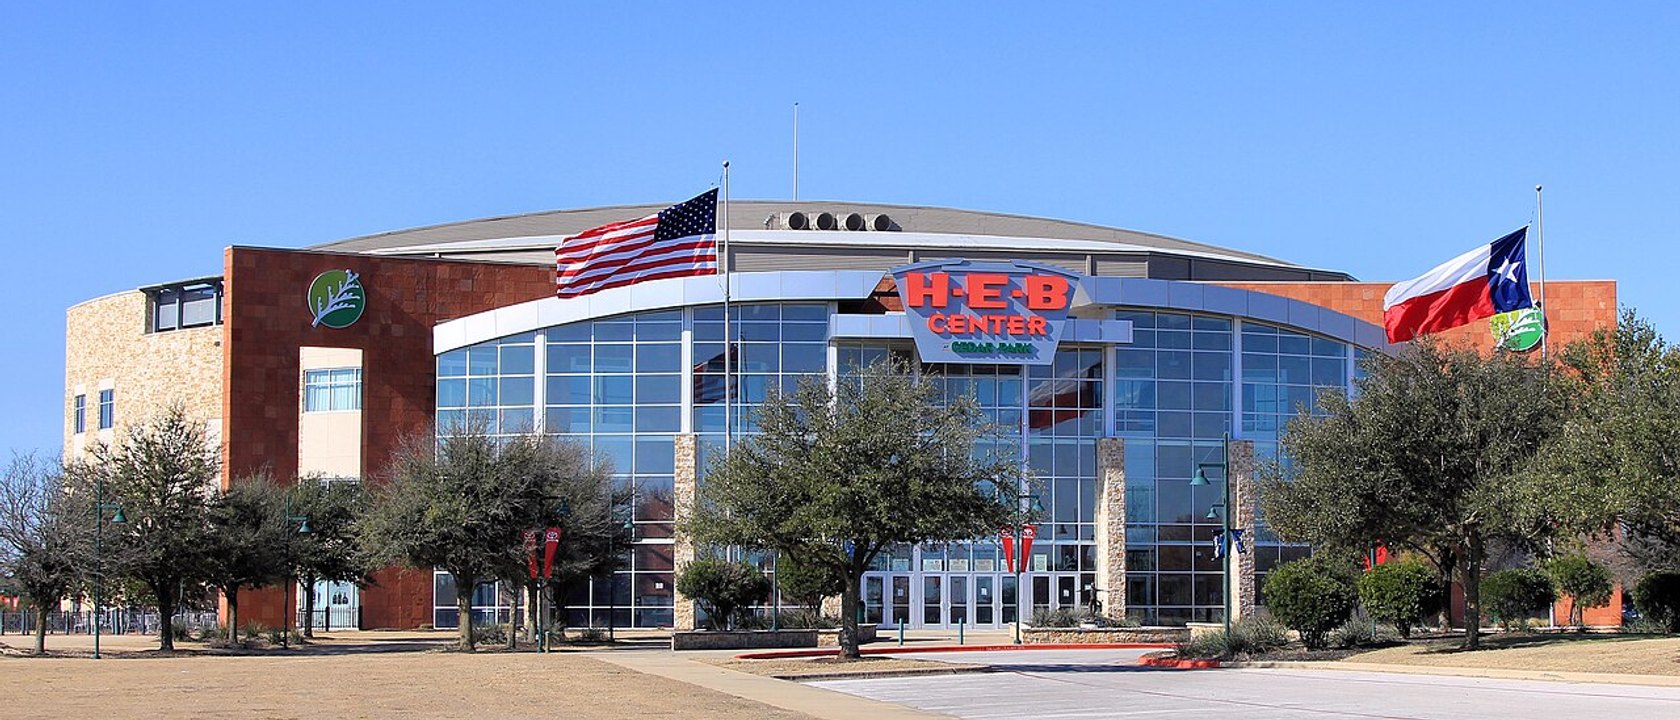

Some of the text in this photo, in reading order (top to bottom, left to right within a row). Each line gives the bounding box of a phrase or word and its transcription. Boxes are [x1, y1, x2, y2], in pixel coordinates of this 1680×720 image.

[906, 272, 1069, 310] H-E-B
[928, 313, 1047, 335] CENTER
[952, 341, 993, 353] CEDAR
[998, 342, 1033, 353] PARK
